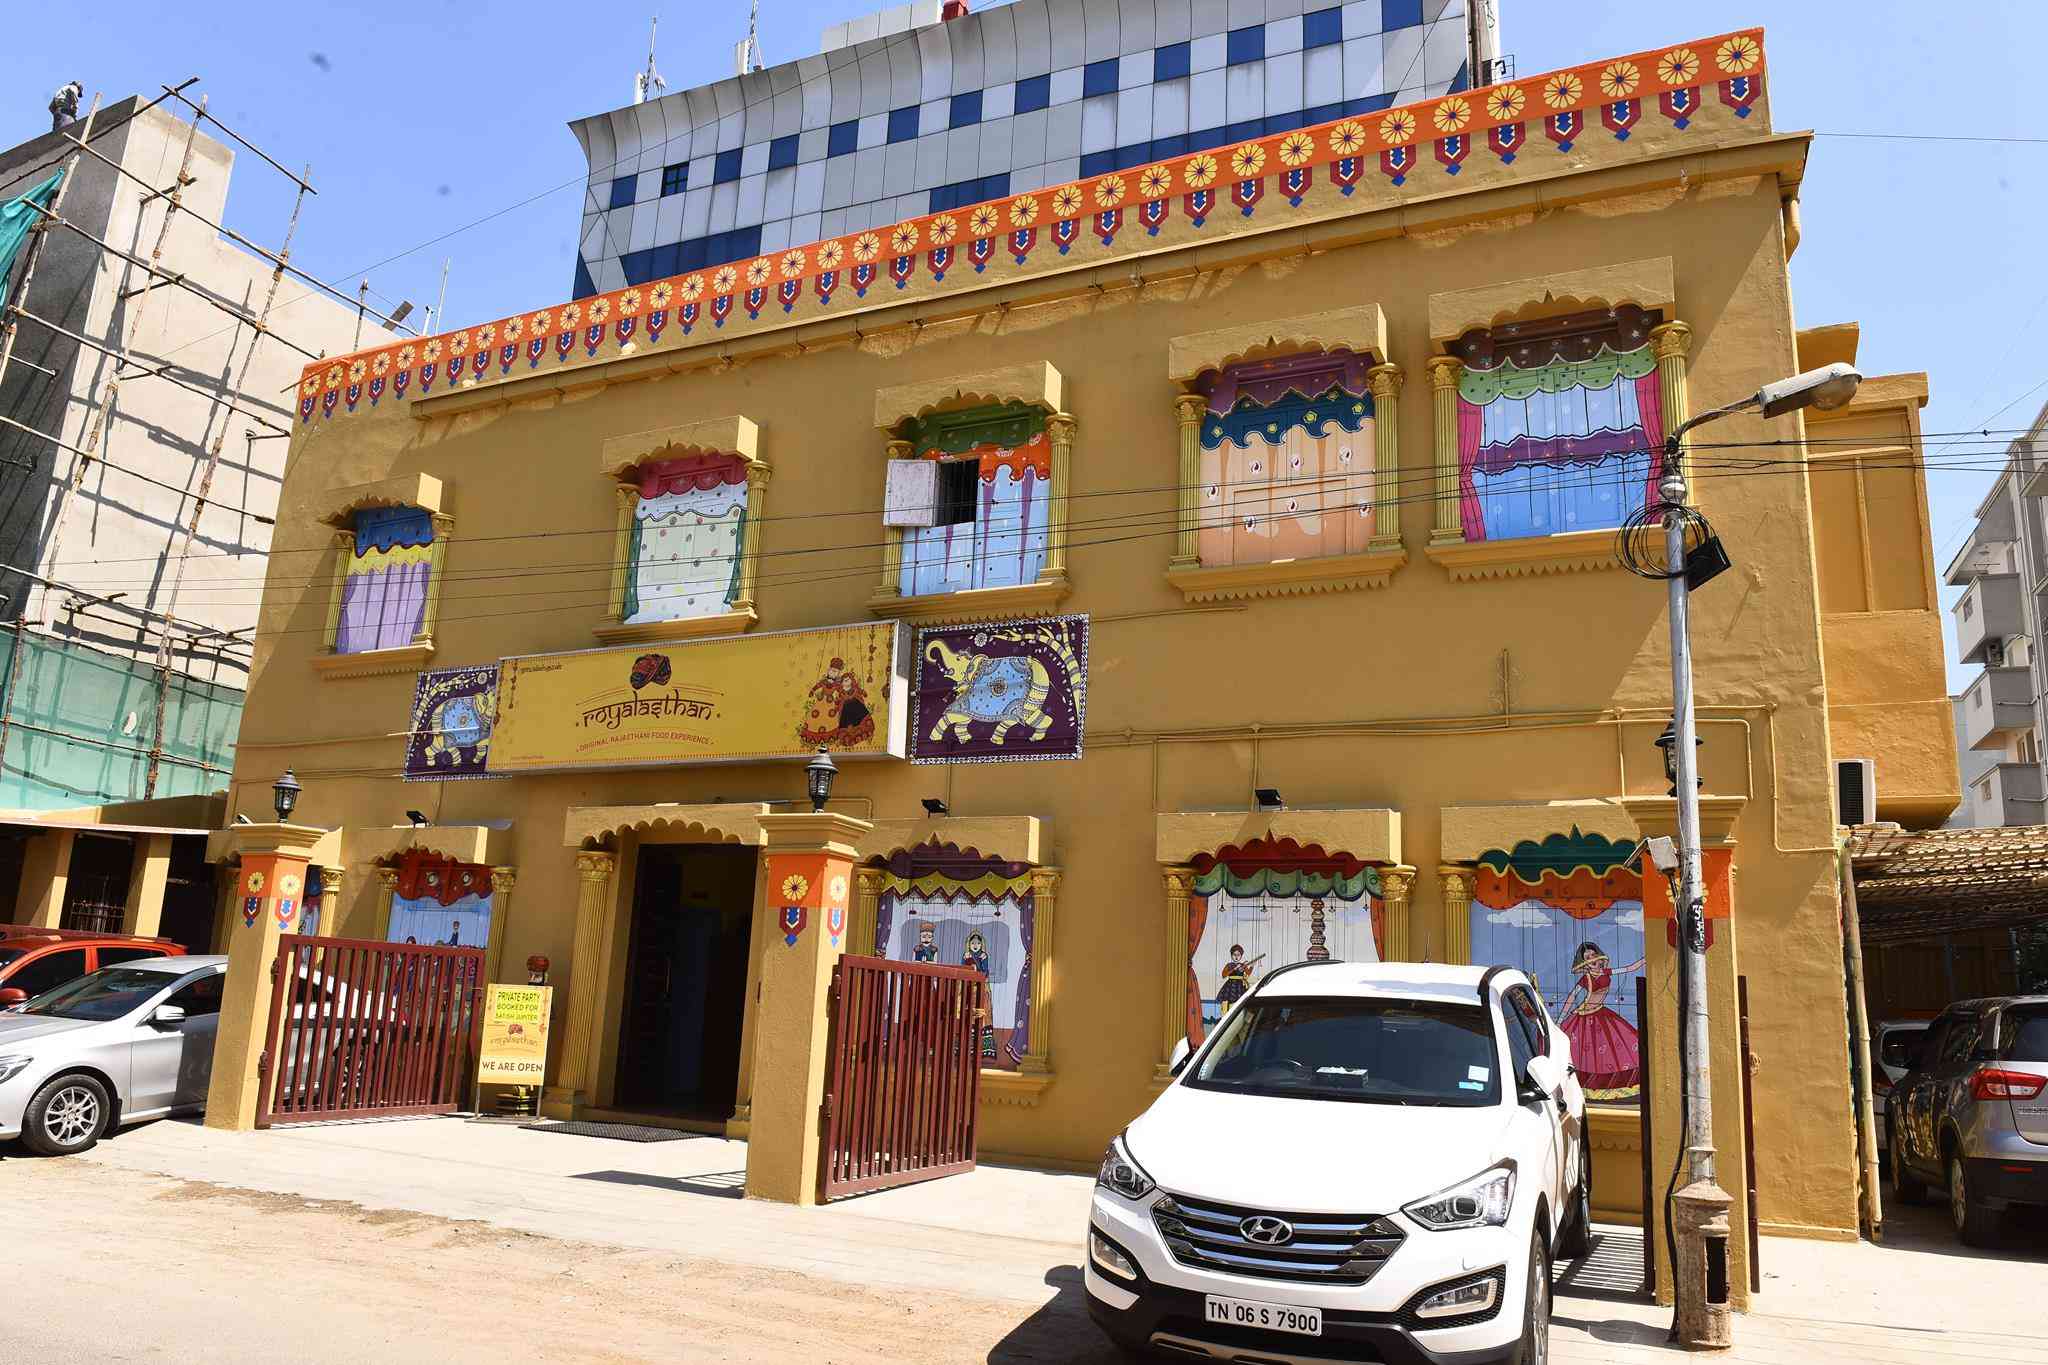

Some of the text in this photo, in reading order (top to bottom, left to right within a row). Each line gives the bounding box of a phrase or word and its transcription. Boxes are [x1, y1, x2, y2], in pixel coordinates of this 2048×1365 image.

[582, 689, 715, 730] royalasthan
[579, 731, 710, 751] ORIGINAL RAJASTHANI FOOD EXPERIENCE
[498, 991, 540, 1002] PRIVATE PARTY
[482, 1061, 543, 1072] WE ARE OPEN
[1208, 1302, 1318, 1332] TN 06 S 7900
